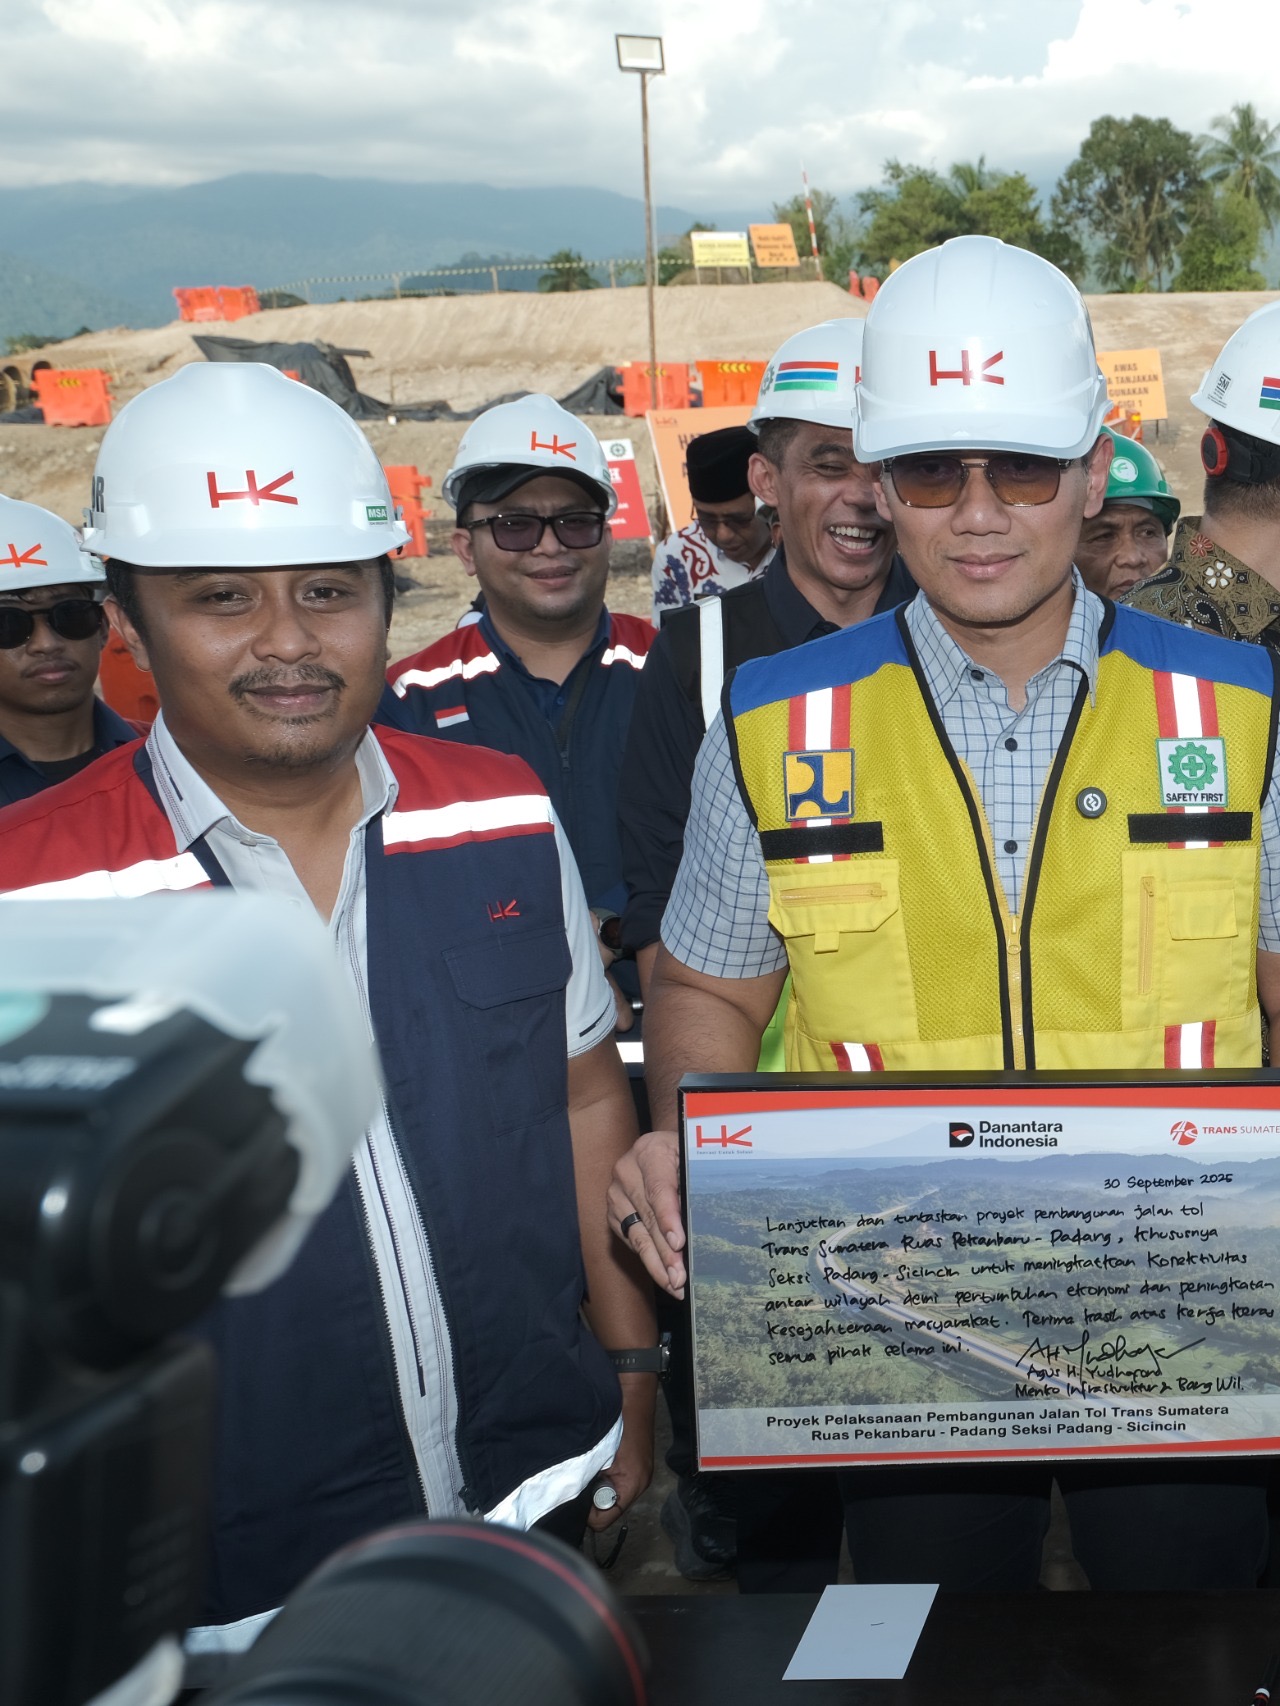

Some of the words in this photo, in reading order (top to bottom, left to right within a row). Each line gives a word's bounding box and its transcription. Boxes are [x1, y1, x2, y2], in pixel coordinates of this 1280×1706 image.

[929, 350, 1004, 386] HK
[1114, 363, 1138, 372] AWAS
[1116, 374, 1158, 384] TANJAKAN
[531, 431, 576, 461] HK
[207, 470, 298, 508] HK
[368, 508, 387, 518] MSA
[1166, 793, 1198, 802] SAFETY
[1200, 793, 1223, 802] FIRST
[487, 899, 520, 923] HK
[696, 1125, 752, 1147] HK
[979, 1121, 1063, 1134] Danantara
[1203, 1126, 1237, 1134] TRANS
[979, 1135, 1058, 1148] Indonesia
[1104, 1178, 1120, 1189] 30
[1127, 1176, 1194, 1193] September
[767, 1216, 845, 1236] Lanjutkan
[857, 1215, 884, 1229] dan
[894, 1209, 967, 1223] tuntaskan
[977, 1207, 1024, 1224] proyek
[1034, 1206, 1124, 1223] pembangunan
[1134, 1204, 1173, 1221] jalan
[1181, 1202, 1203, 1216] tol
[761, 1243, 809, 1258] Trans
[819, 1240, 889, 1257] Sumatera
[901, 1235, 943, 1253] Ruas
[953, 1232, 1030, 1250] Pekanbaru
[769, 1269, 810, 1288] Seksi
[896, 1264, 959, 1282] Sicincin
[971, 1259, 1015, 1275] untuk
[1024, 1254, 1135, 1273] meningkatkan
[765, 1297, 813, 1312] antar
[824, 1293, 890, 1310] wilayah
[903, 1290, 938, 1305] demi
[956, 1287, 1058, 1306] pertumbuhan
[1067, 1283, 1130, 1298] ekonomi
[1140, 1280, 1170, 1294] dan
[1180, 1277, 1274, 1300] peningkatan
[1022, 1311, 1075, 1328] Terima
[1130, 1306, 1166, 1320] atas
[769, 1352, 816, 1365] semua
[828, 1344, 871, 1365] pihak
[885, 1342, 934, 1356] selama
[1026, 1366, 1060, 1383] Agus
[1015, 1384, 1060, 1397] Menko
[1217, 1377, 1244, 1392] Wil.
[767, 1415, 819, 1429] Proyek
[825, 1412, 922, 1426] Pelaksanaan
[927, 1410, 1035, 1424] Pembangunan
[1039, 1407, 1080, 1419] Jalan
[1085, 1406, 1107, 1418] Tol
[1111, 1406, 1153, 1418] Trans
[1158, 1405, 1229, 1416] Sumatera
[811, 1430, 849, 1441] Ruas
[854, 1428, 935, 1440] Pekanbaru
[950, 1425, 1006, 1438] Padang
[1012, 1423, 1052, 1435] Seksi
[1056, 1422, 1113, 1435] Padang
[1127, 1421, 1186, 1432] Sicincin
